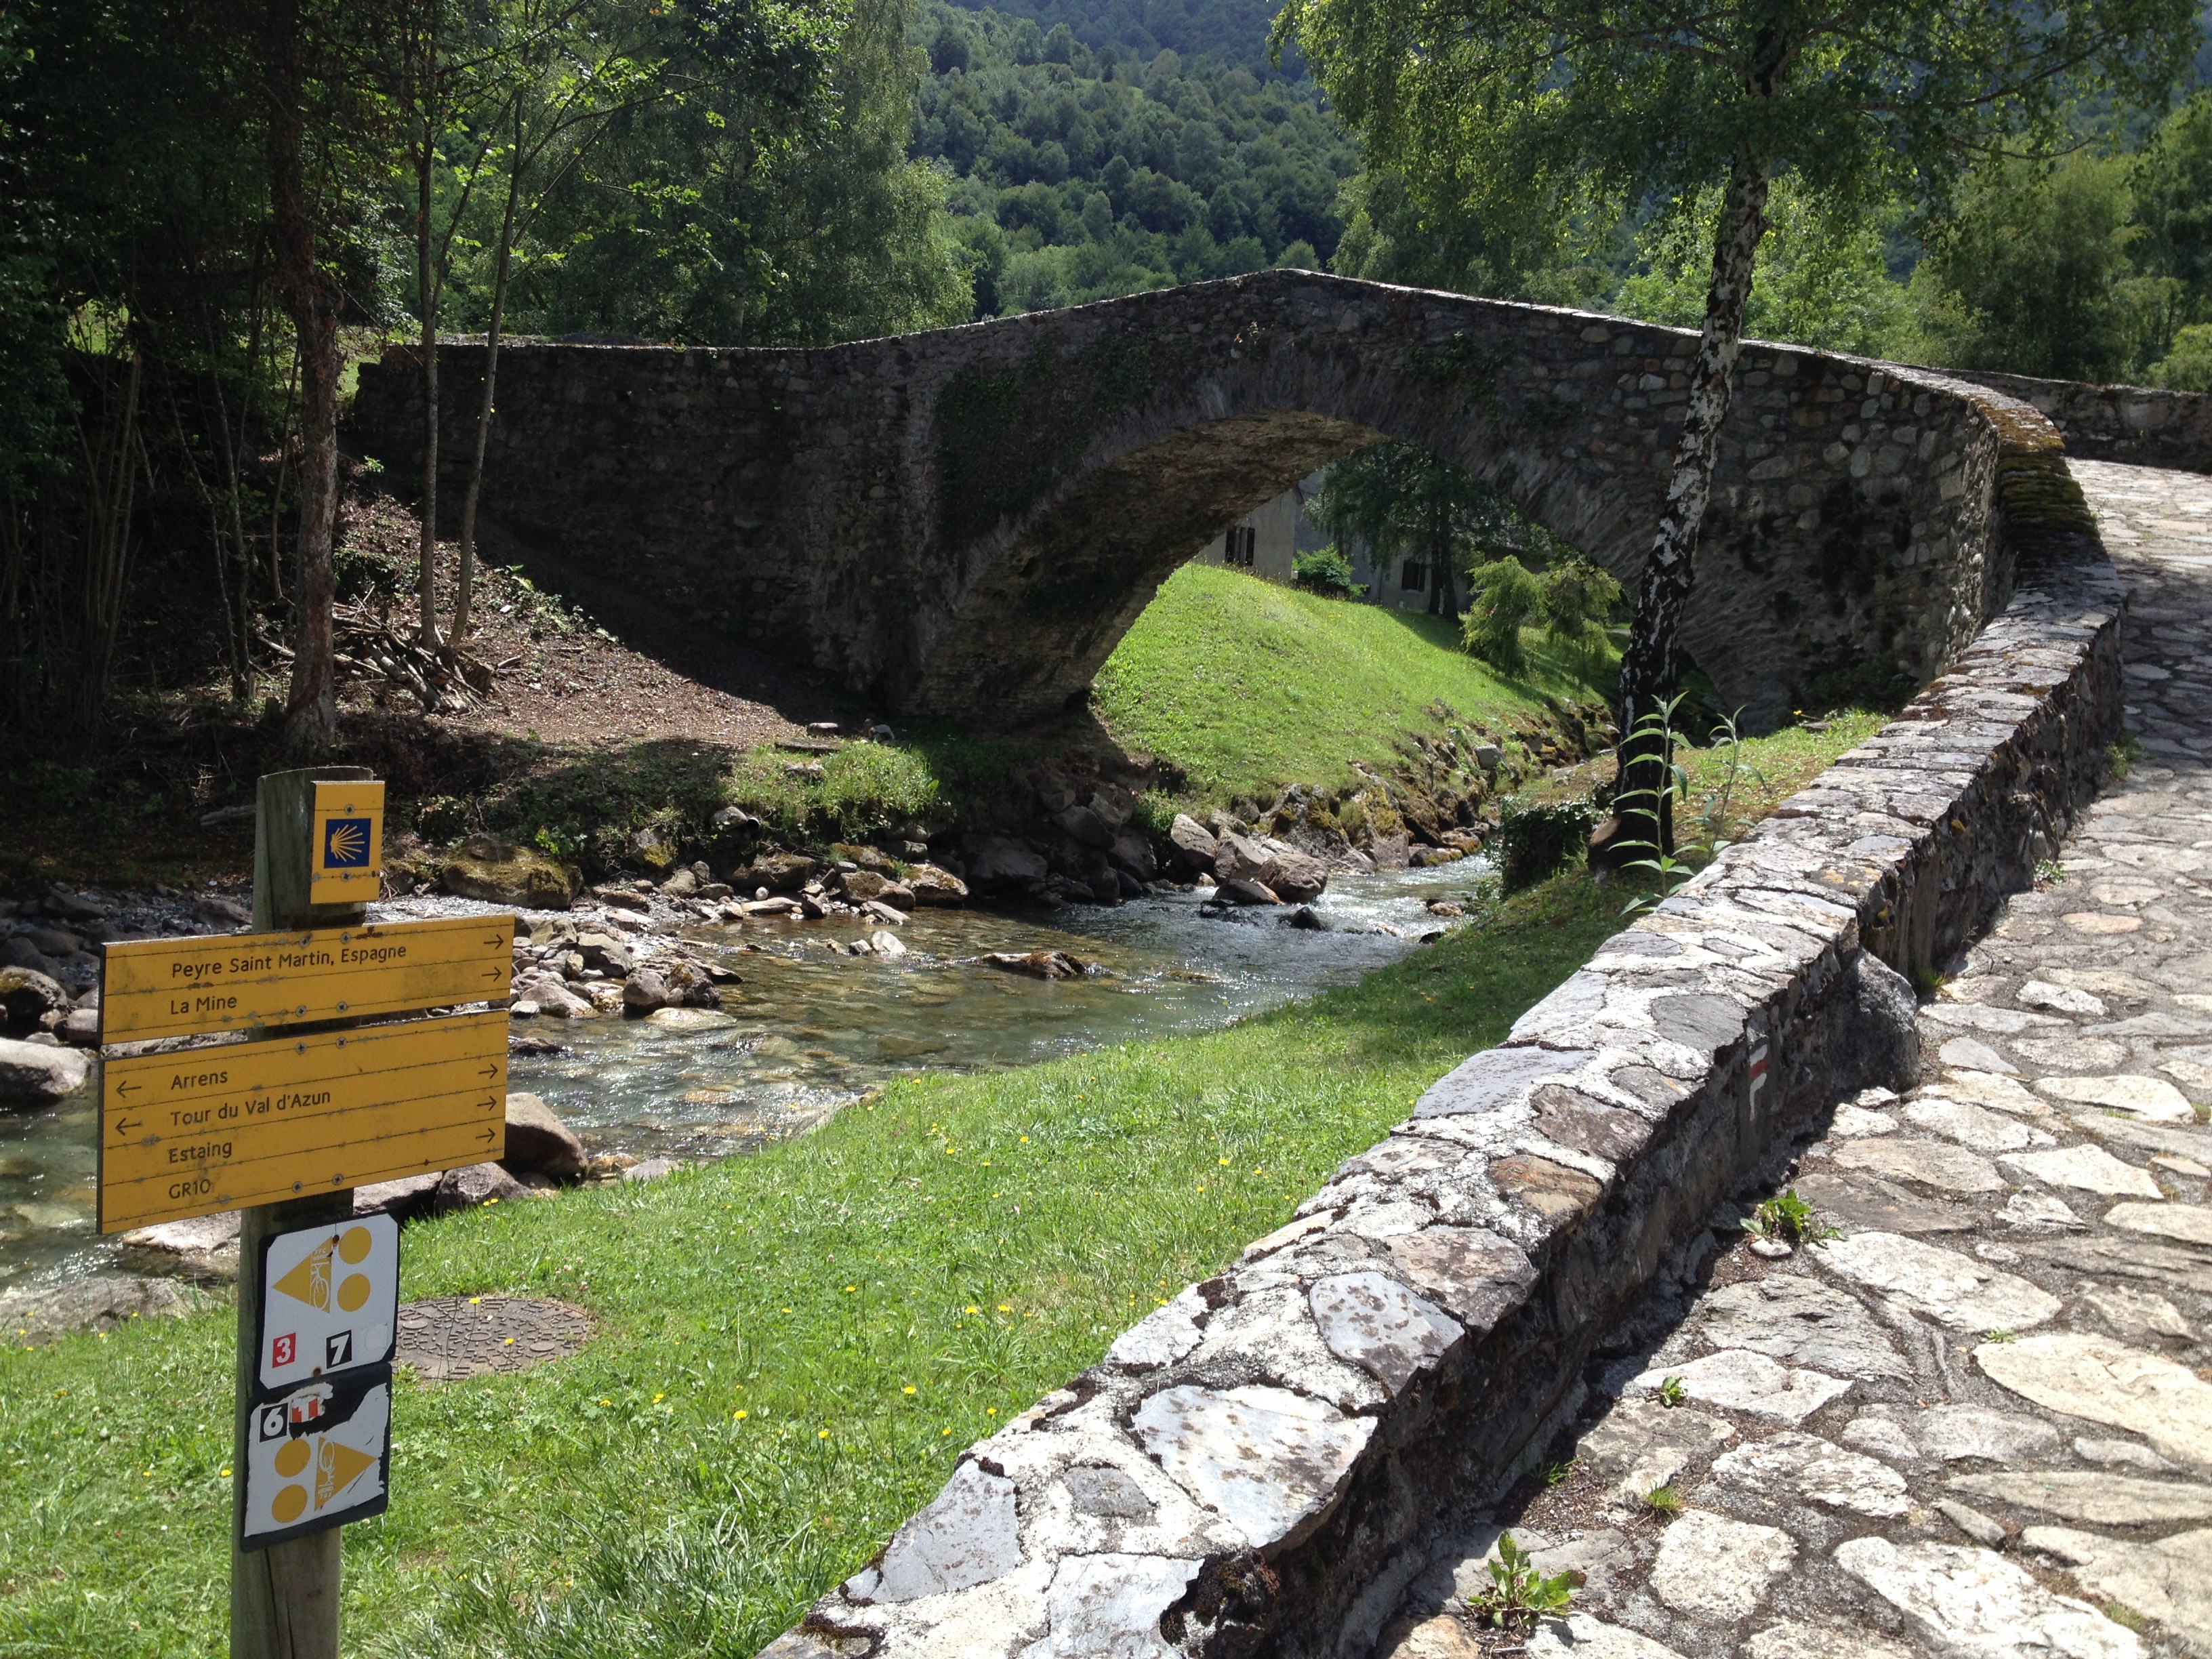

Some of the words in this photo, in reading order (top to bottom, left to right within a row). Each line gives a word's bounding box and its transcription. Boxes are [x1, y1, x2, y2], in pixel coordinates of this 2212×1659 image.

[172, 962, 222, 980] Peyre
[229, 956, 272, 973] Saint
[279, 950, 334, 968] Martin,
[341, 946, 407, 964] Espagne
[171, 1000, 189, 1015] La
[196, 996, 237, 1012] Mine
[171, 1071, 228, 1090] Arrens
[171, 1109, 211, 1126] Tour
[218, 1102, 239, 1119] du
[245, 1097, 270, 1115] Val
[276, 1091, 331, 1111] d'Azun
[169, 1141, 232, 1164] Estaing
[169, 1179, 211, 1199] GR10
[276, 1338, 291, 1364] 3
[331, 1334, 350, 1366] 7
[263, 1406, 284, 1437] 6
